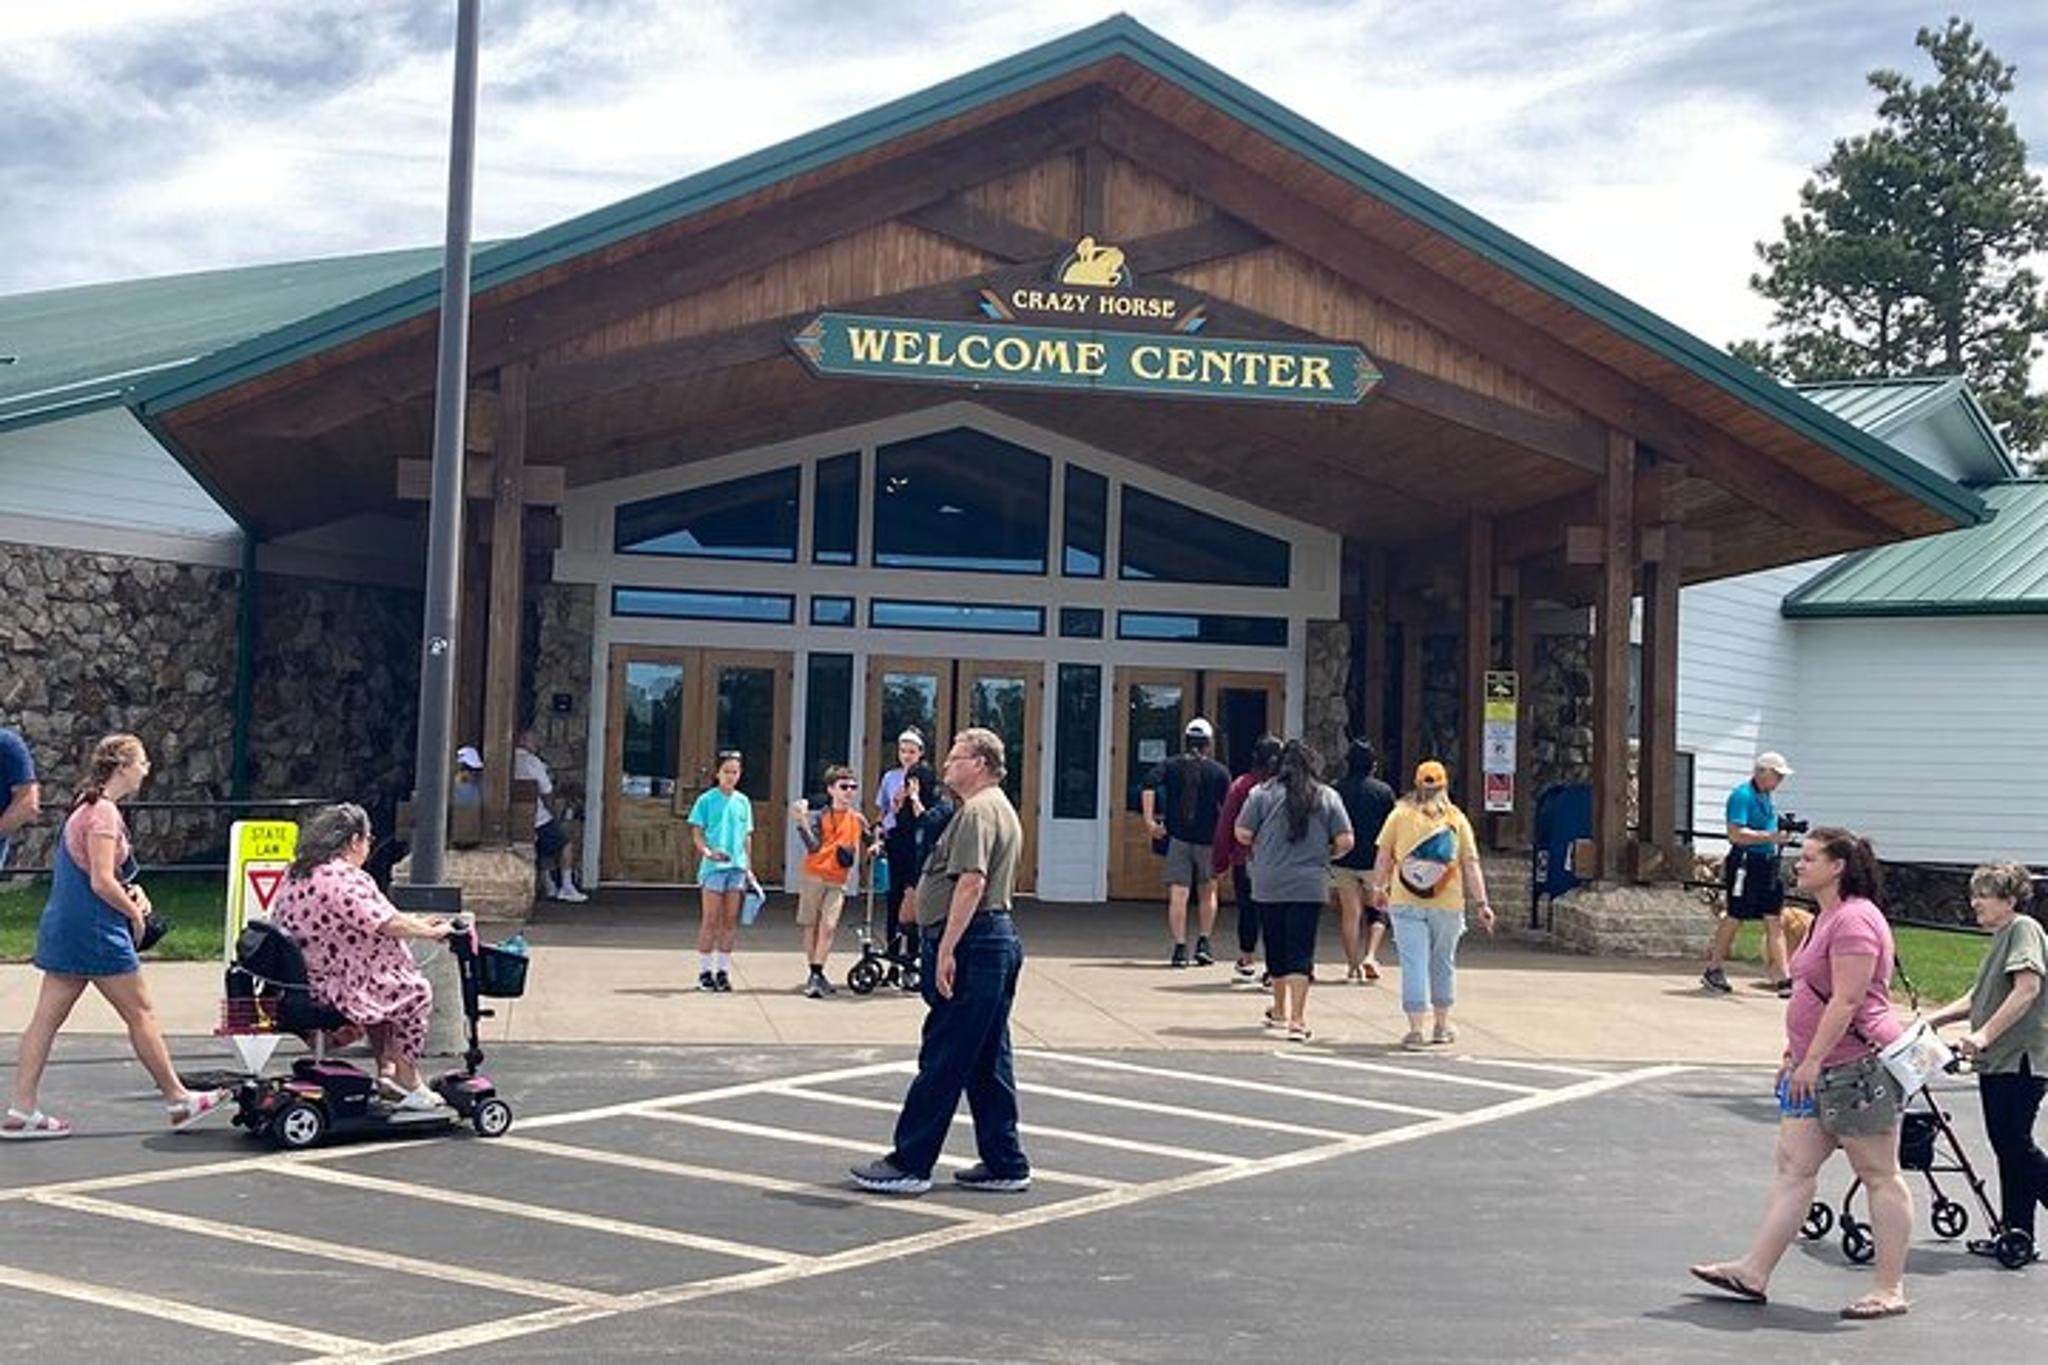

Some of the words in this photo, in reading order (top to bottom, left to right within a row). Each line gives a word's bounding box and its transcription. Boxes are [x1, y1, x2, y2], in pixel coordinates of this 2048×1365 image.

[1012, 289, 1091, 313] CRAZY
[1099, 295, 1177, 319] HORSE
[847, 326, 1108, 376] WELCOME
[1129, 344, 1335, 391] CENTER
[251, 826, 287, 841] STATE
[255, 844, 280, 857] LAW
